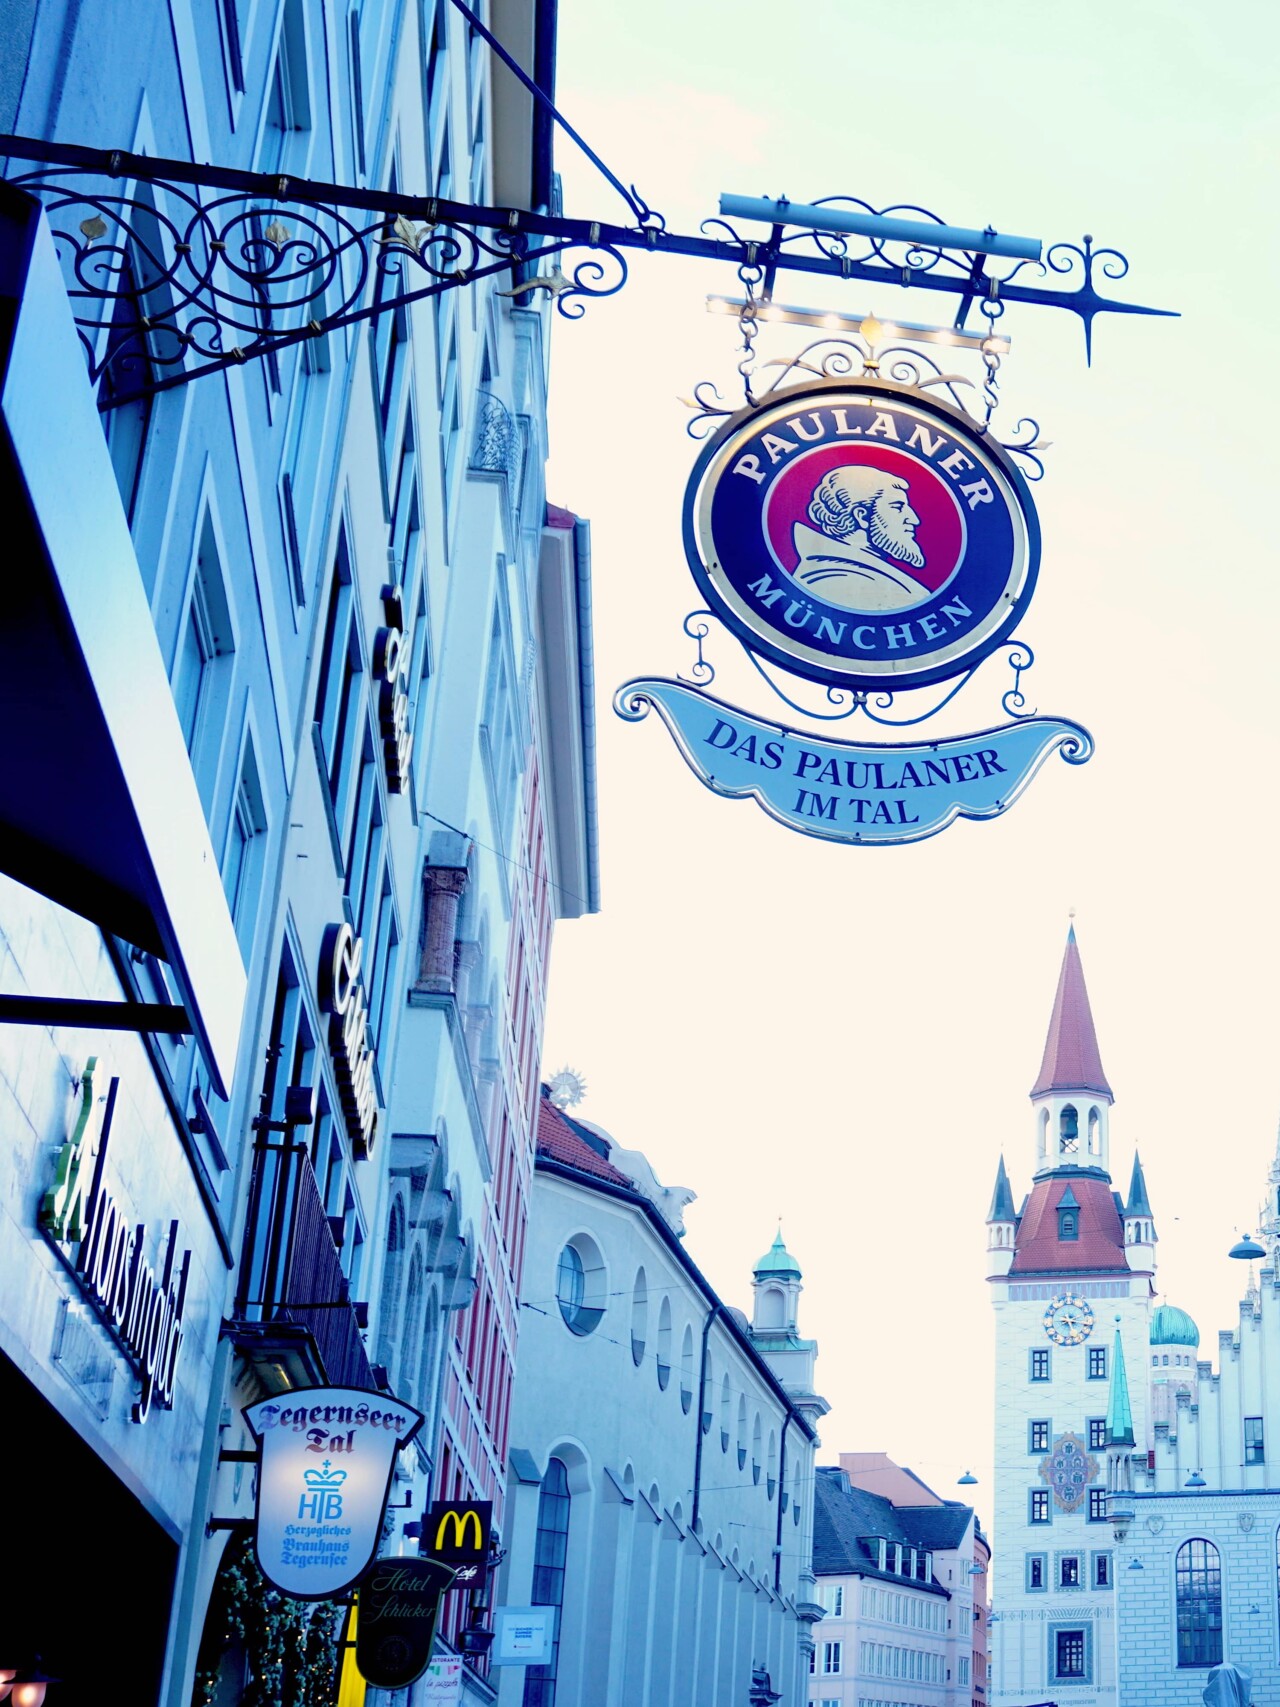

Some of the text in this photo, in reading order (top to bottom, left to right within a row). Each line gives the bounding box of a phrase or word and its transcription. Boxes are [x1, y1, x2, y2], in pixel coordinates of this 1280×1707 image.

[732, 406, 995, 512] PAULANER
[747, 572, 973, 652] MÜNCHEN
[704, 718, 1008, 791] DAS PAULANER
[792, 787, 920, 826] IM TAL
[257, 1403, 407, 1433] Tegernseer
[305, 1428, 357, 1453] Tal
[284, 1524, 351, 1537] Herzogliches
[282, 1538, 350, 1554] Brauhaus
[371, 1566, 431, 1591] Hotel
[362, 1594, 436, 1624] Schlicker
